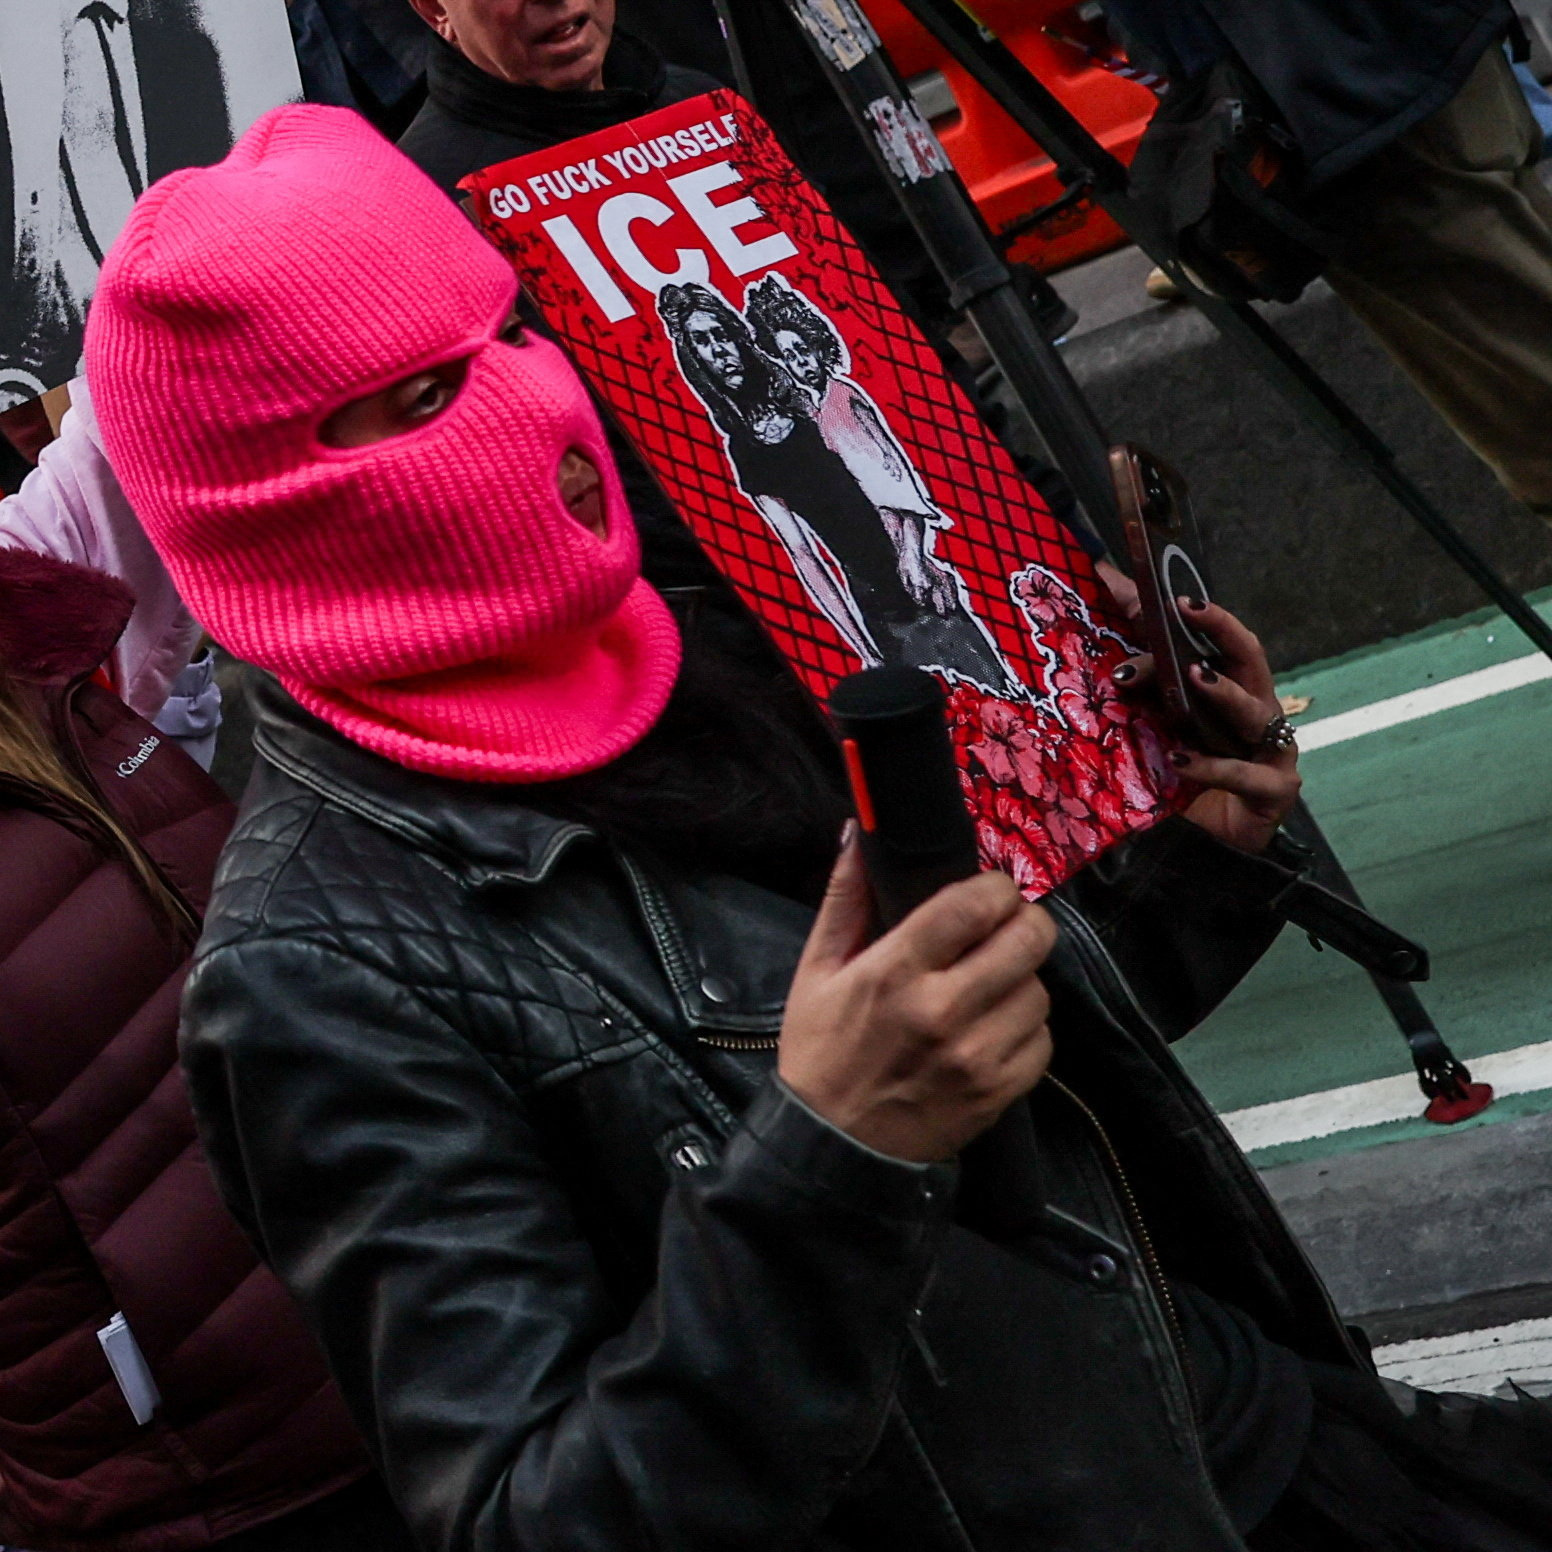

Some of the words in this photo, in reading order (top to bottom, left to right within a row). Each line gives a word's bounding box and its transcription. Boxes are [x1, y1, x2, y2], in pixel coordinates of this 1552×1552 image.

[489, 183, 531, 219] GO
[526, 158, 613, 206] FUCK
[601, 113, 741, 179] YOURSELF
[540, 159, 799, 324] ICE
[118, 735, 161, 775] Columbia
